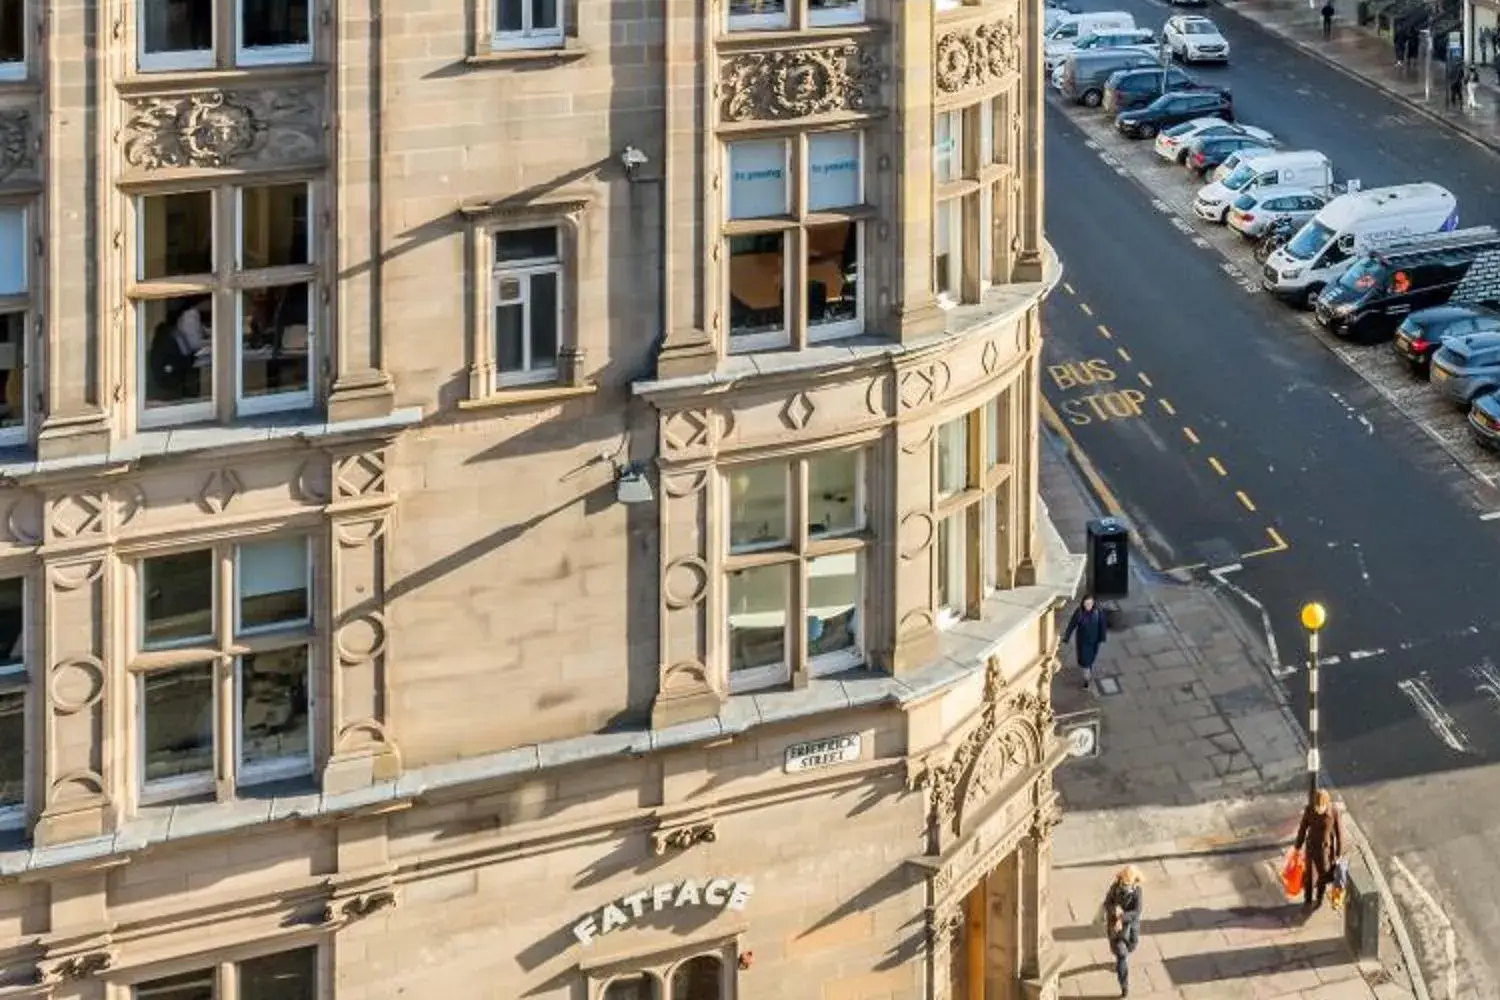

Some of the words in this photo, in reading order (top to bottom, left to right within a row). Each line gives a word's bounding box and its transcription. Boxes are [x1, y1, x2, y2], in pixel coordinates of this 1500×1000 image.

[1048, 359, 1117, 391] BUS
[1060, 389, 1146, 425] STOP
[800, 751, 844, 768] STREET
[573, 878, 754, 949] FATFACE
